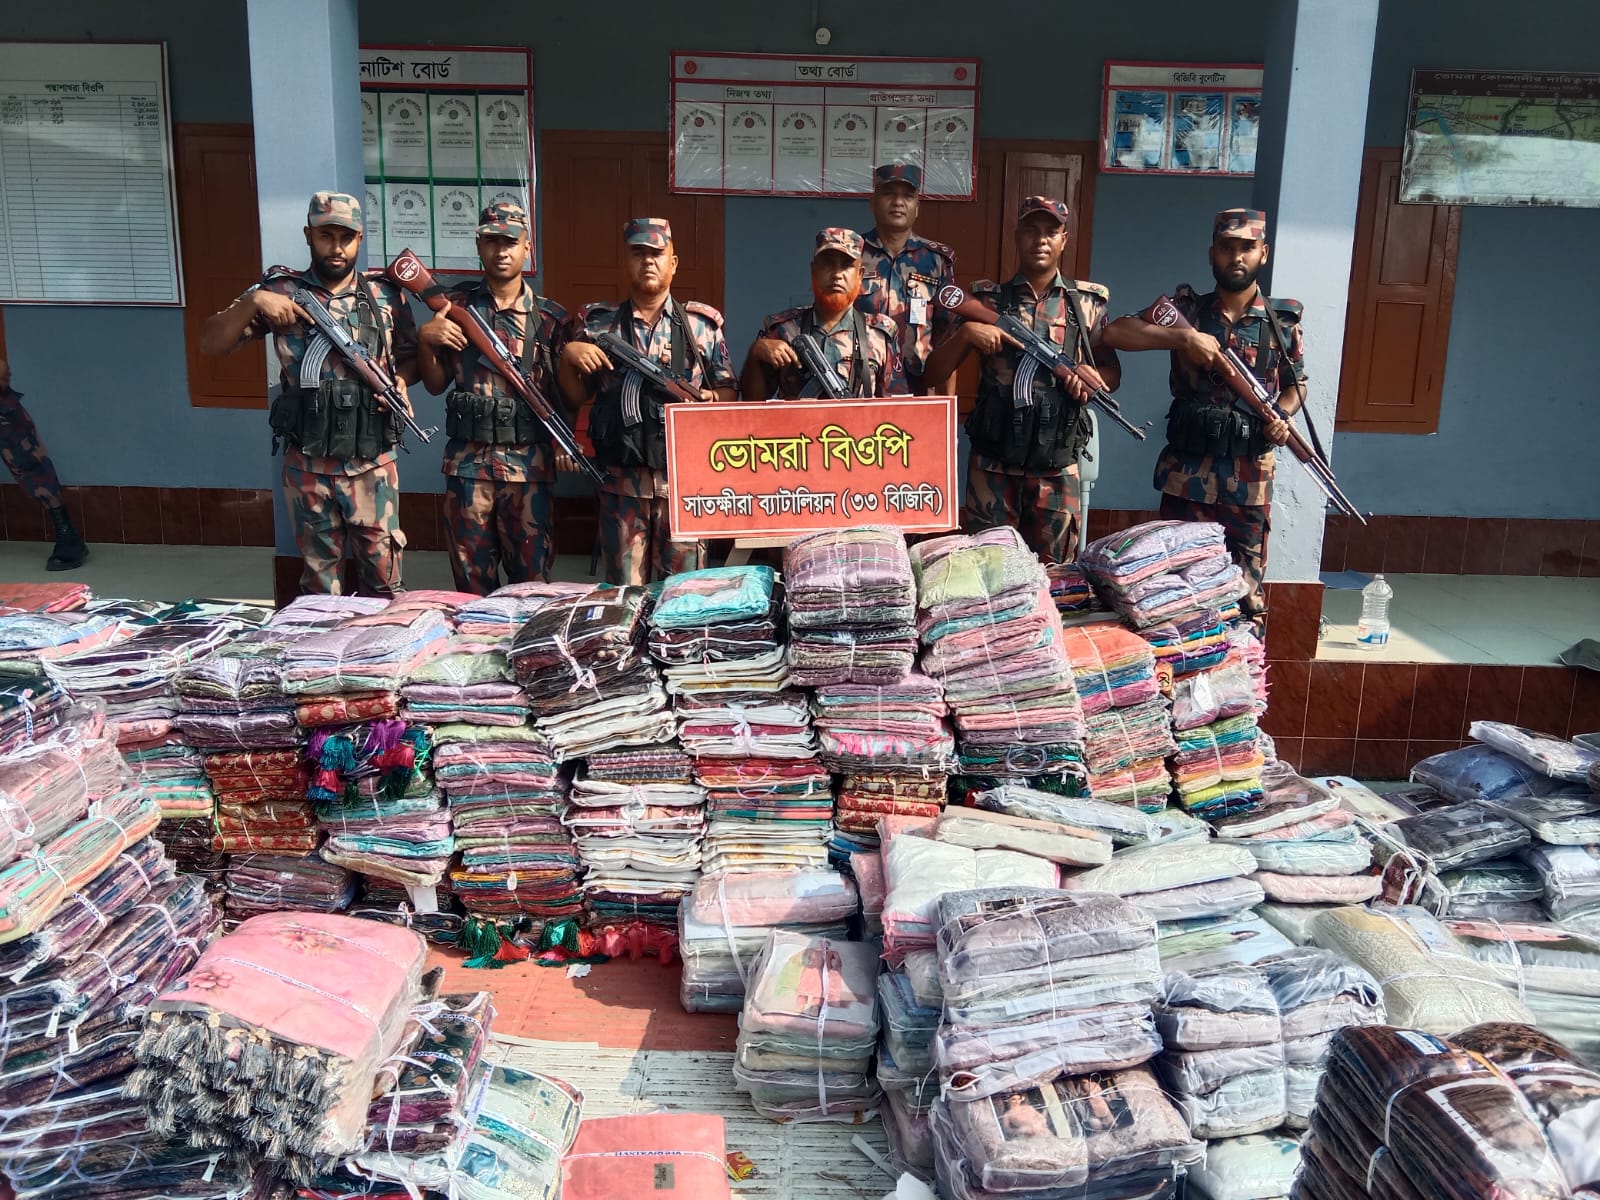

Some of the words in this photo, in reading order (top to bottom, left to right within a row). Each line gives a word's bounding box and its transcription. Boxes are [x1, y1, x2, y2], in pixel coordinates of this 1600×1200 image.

[410, 57, 452, 80] বোর্ড
[799, 65, 823, 79] তথ্য
[827, 63, 856, 79] বোর্ড
[1173, 72, 1197, 84] বিজিবি
[1198, 72, 1226, 85] বুলেটিন
[753, 89, 773, 100] তথ্য
[709, 433, 811, 472] ভোমরা
[819, 422, 914, 471] বিওপি
[682, 487, 753, 517] সাতক্ষীরা
[757, 486, 837, 516] ব্যাটালিয়ন
[841, 488, 878, 518] (৩৩
[883, 483, 943, 516] বিজিবি)
